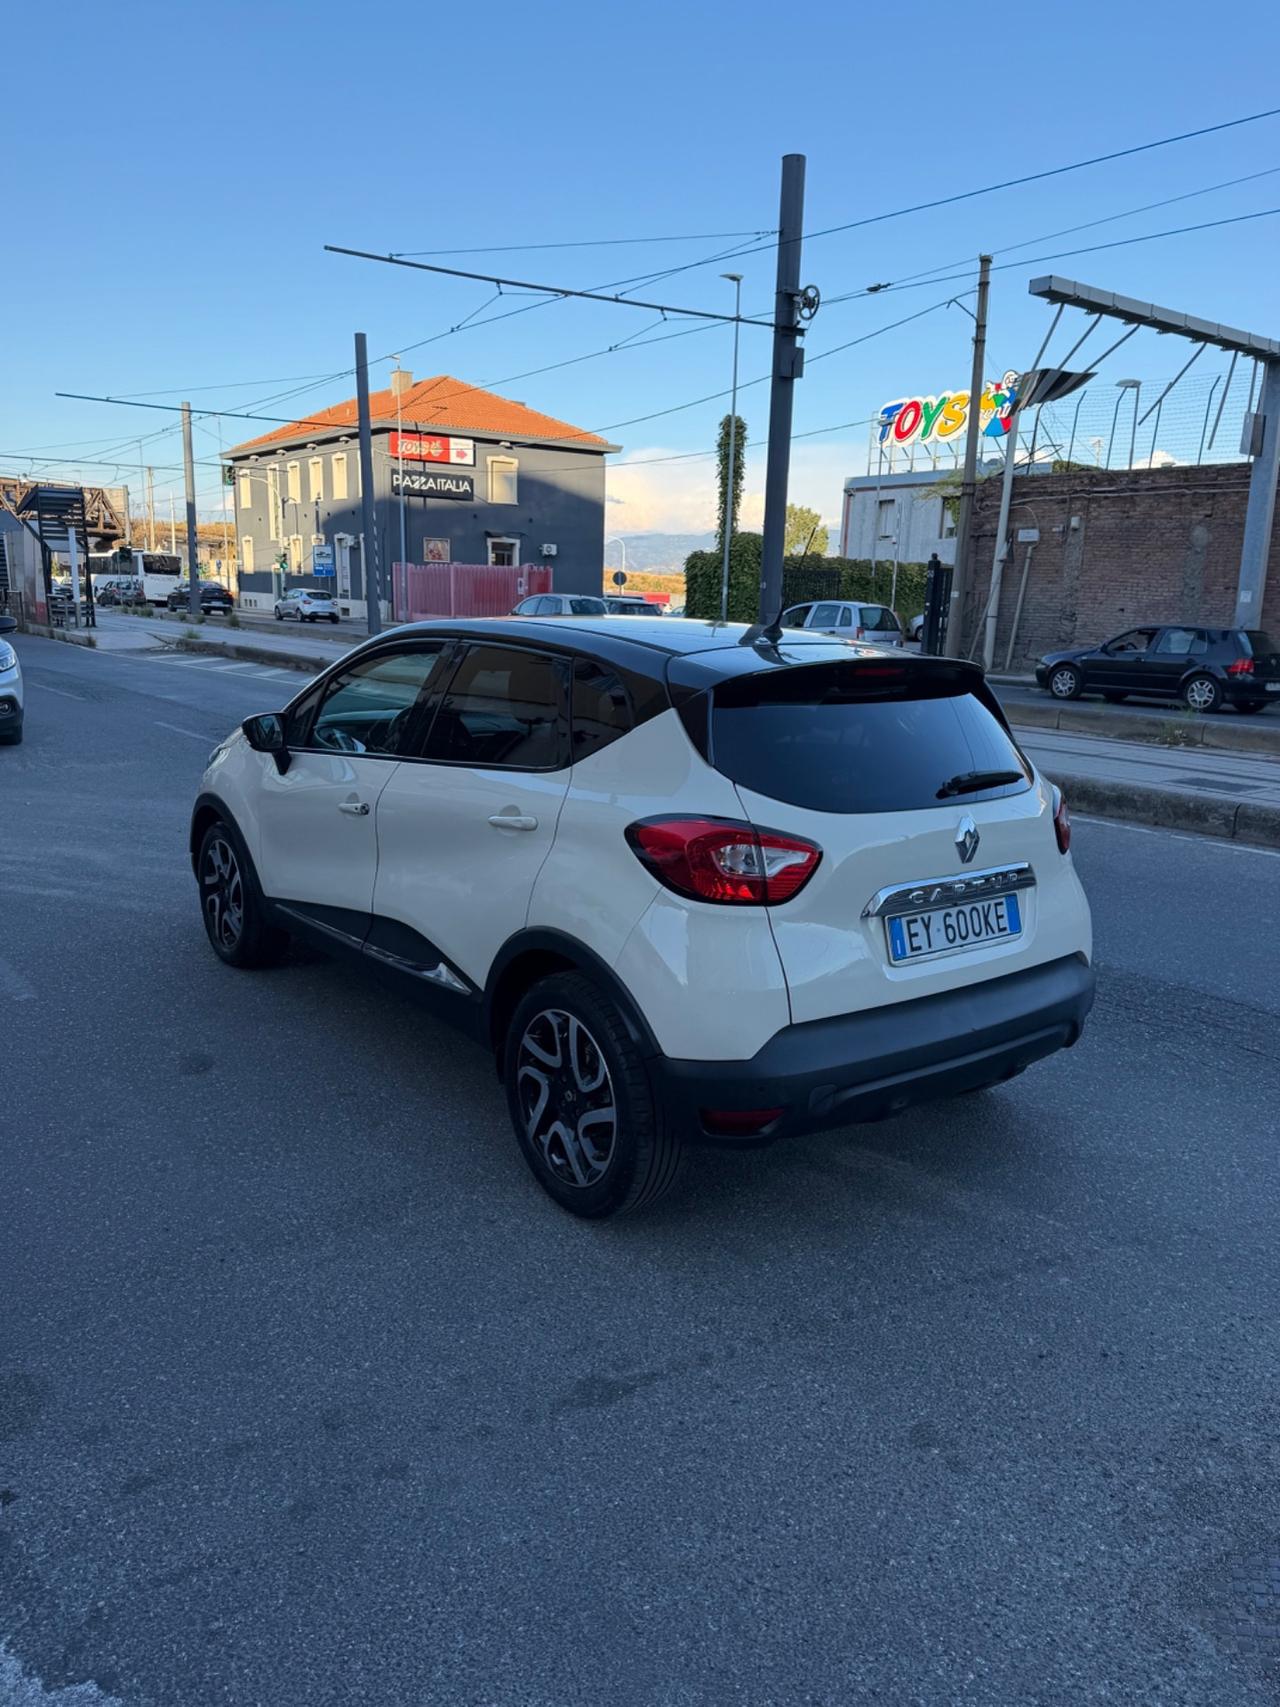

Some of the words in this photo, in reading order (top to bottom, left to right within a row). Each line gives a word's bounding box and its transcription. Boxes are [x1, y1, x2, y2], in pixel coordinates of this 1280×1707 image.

[878, 392, 970, 444] TOYS
[908, 873, 1019, 904] CAPTUR
[905, 914, 933, 952] EY
[943, 901, 1008, 944] 600KE
